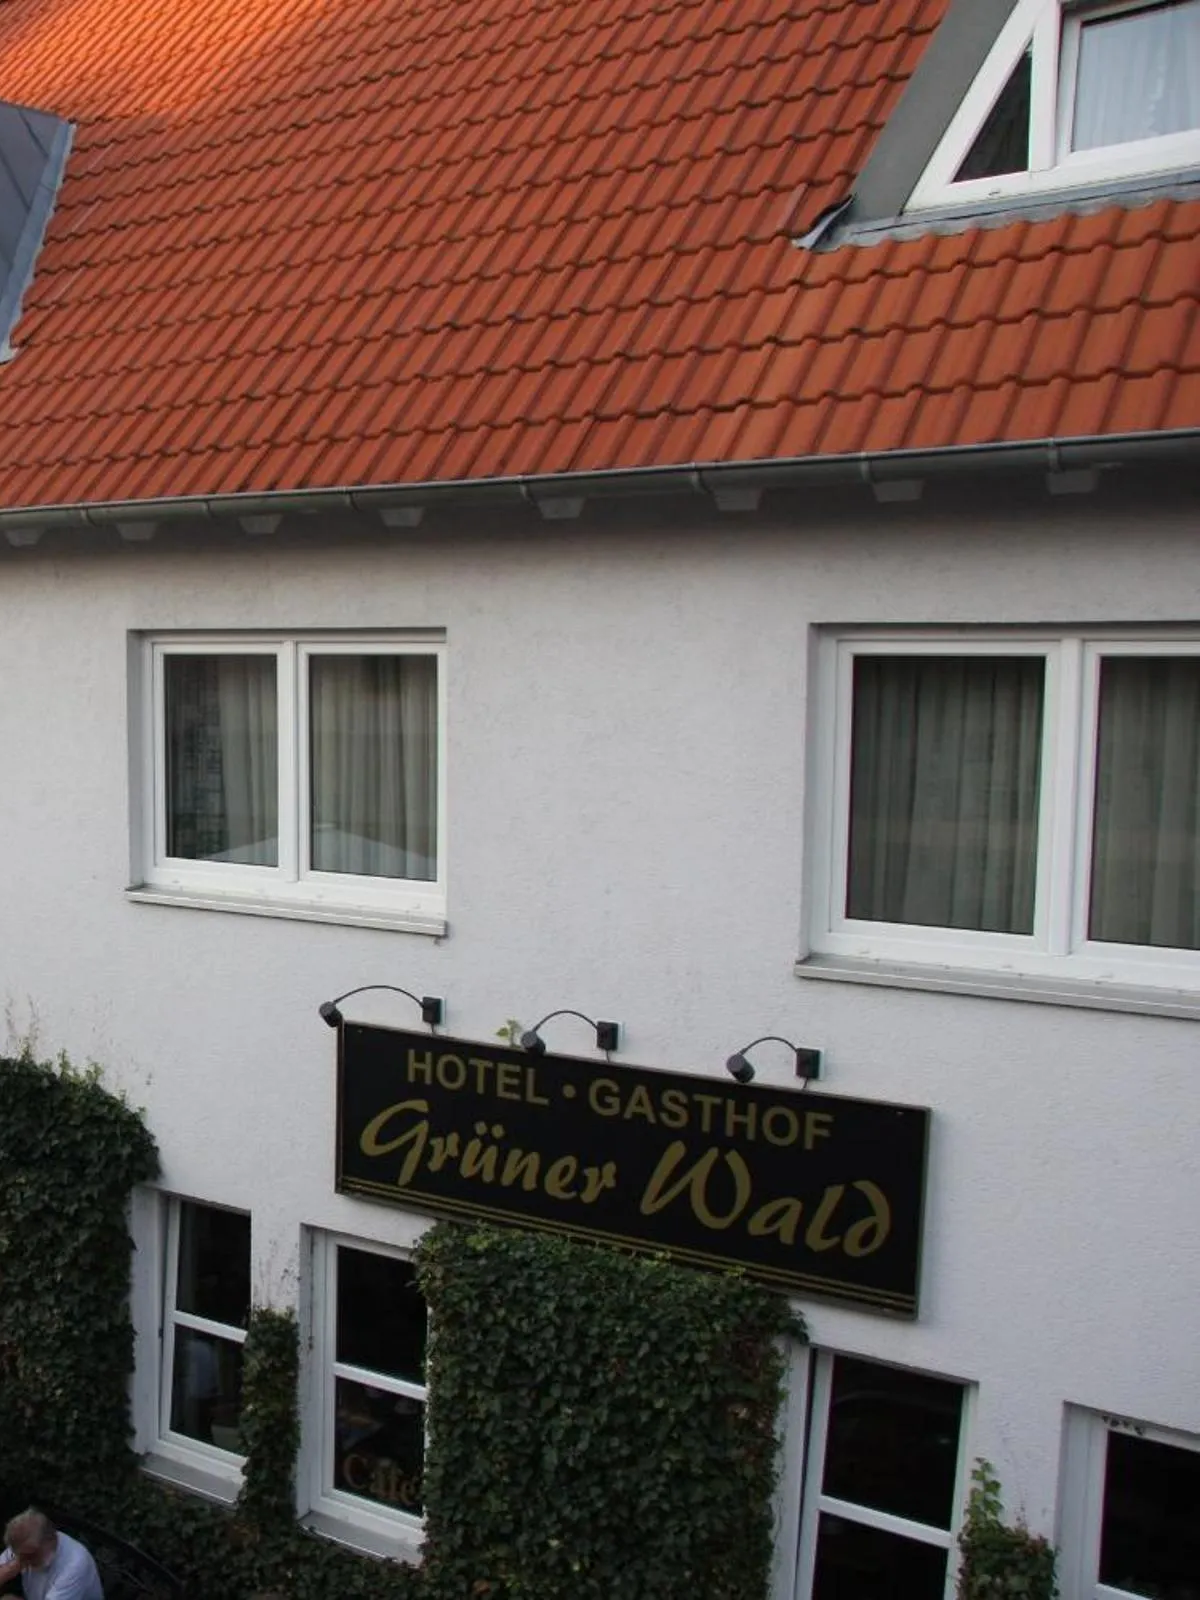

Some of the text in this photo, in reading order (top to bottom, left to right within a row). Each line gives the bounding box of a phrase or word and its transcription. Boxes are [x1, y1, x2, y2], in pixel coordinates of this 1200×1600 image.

[406, 1049, 834, 1150] HOTEL GASTHOF
[360, 1099, 891, 1258] Grüner Wald
